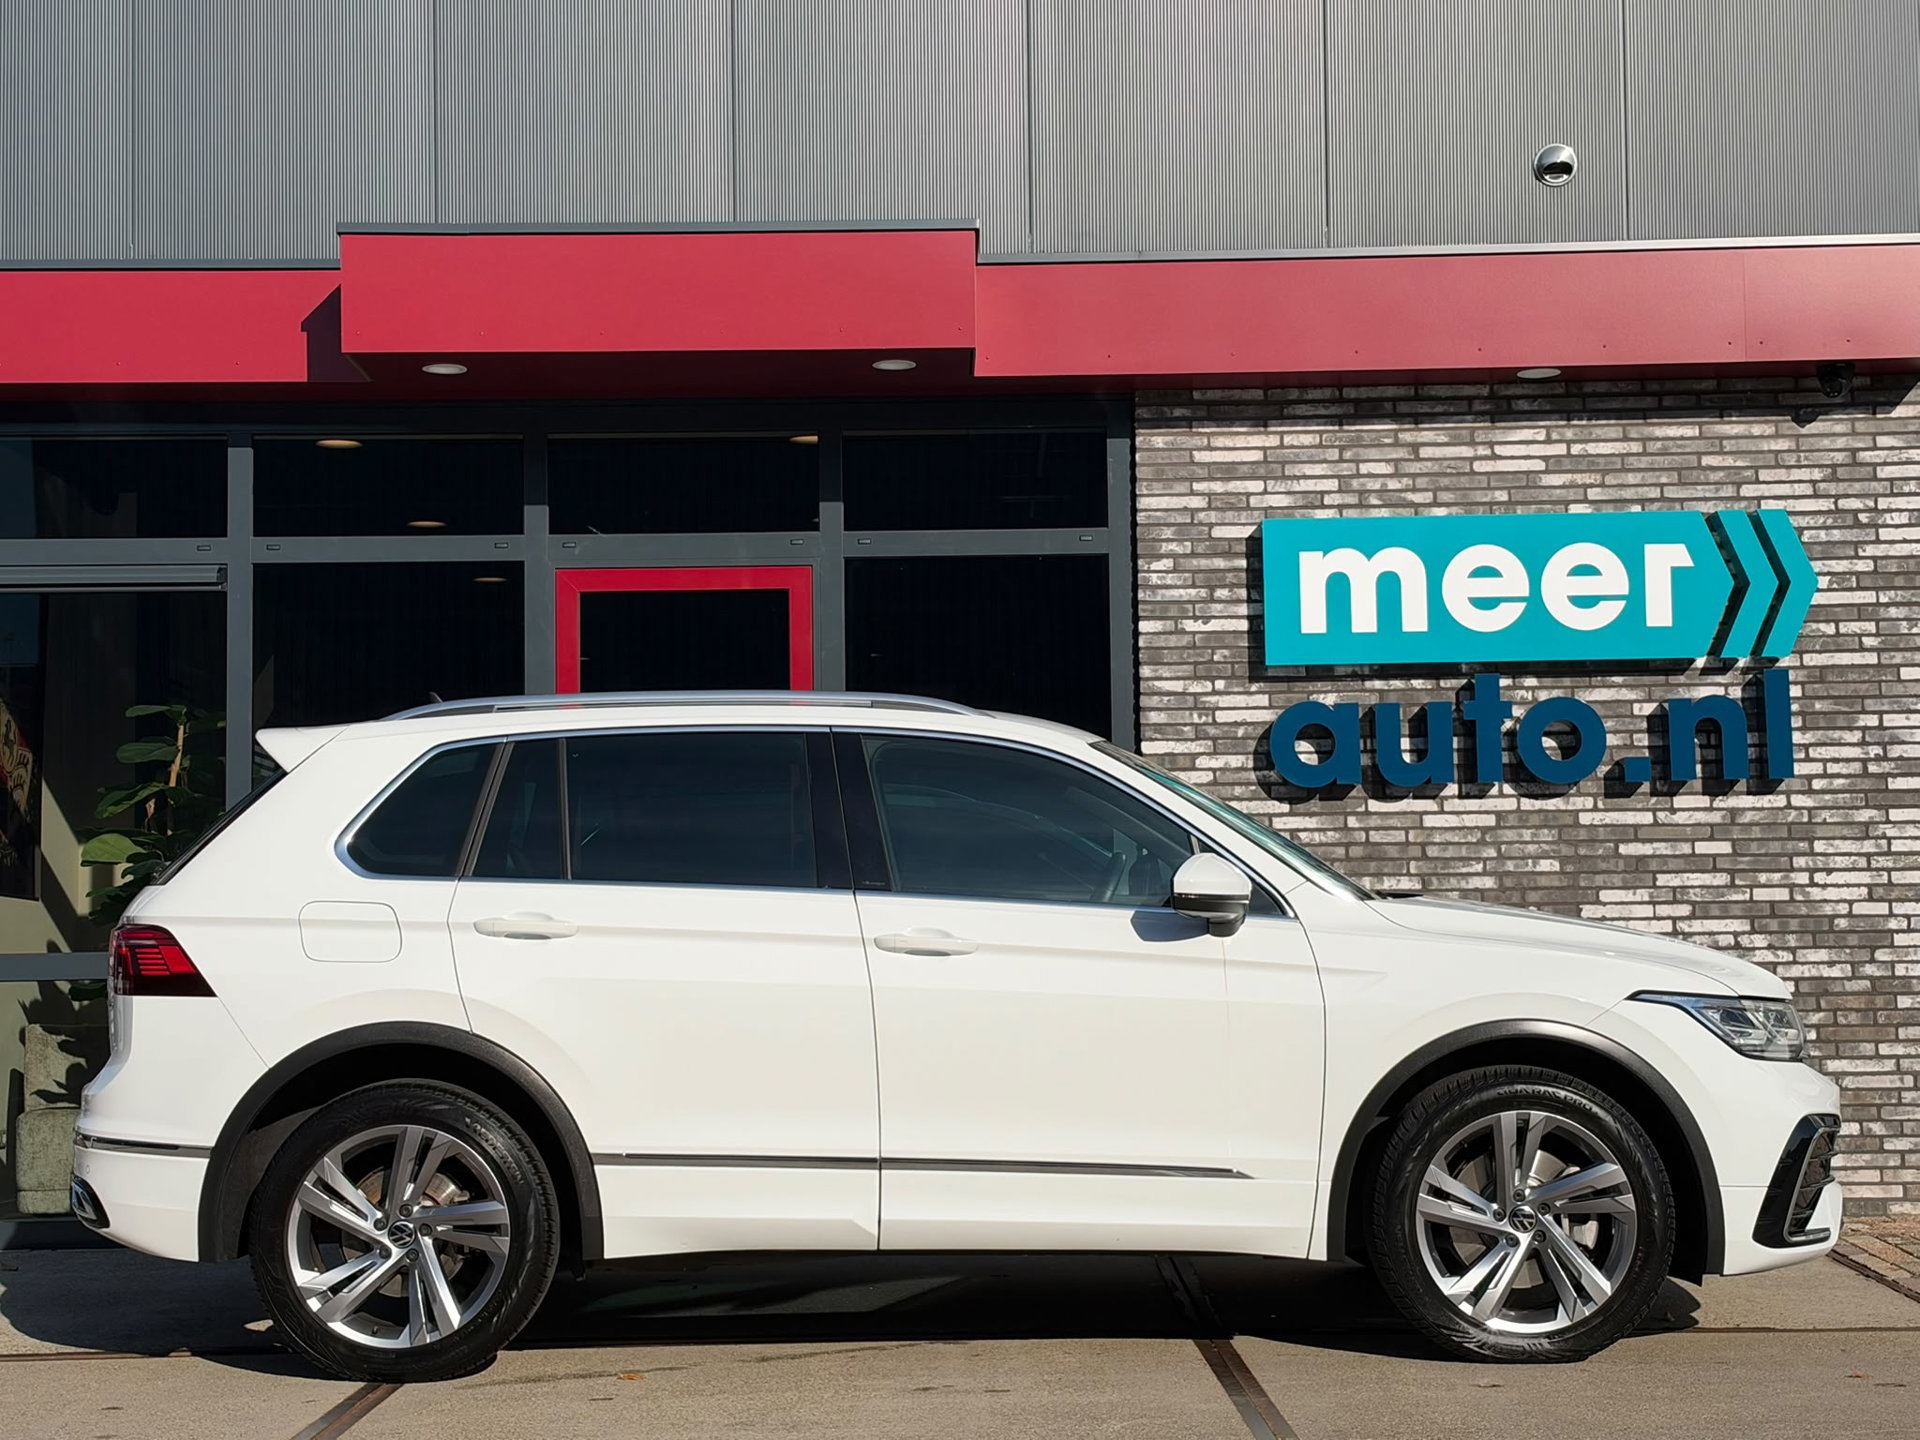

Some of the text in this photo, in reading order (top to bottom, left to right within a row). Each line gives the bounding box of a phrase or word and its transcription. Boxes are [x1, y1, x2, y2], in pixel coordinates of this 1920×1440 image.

[1299, 542, 1695, 634] meer
[1269, 668, 1795, 788] auto.nl
[1496, 1086, 1562, 1100] QUARAC
